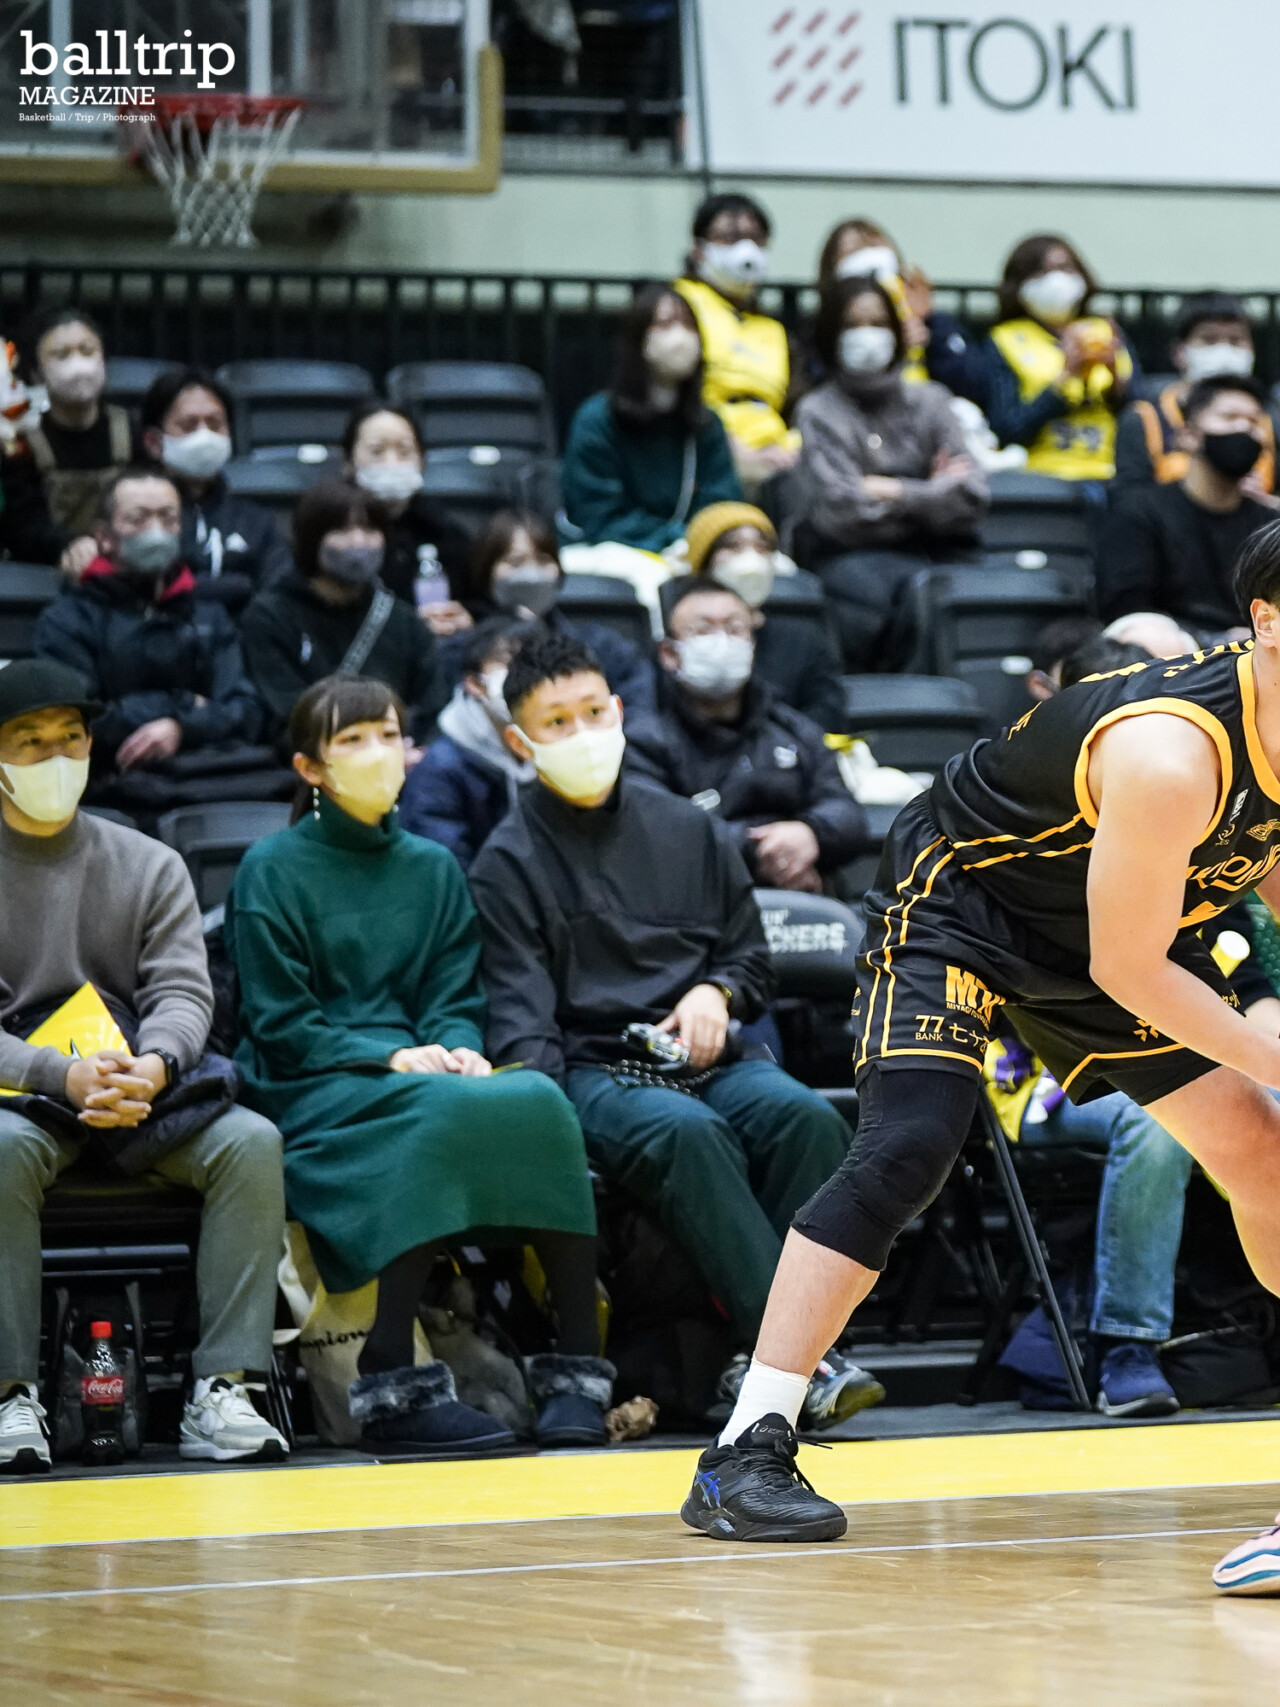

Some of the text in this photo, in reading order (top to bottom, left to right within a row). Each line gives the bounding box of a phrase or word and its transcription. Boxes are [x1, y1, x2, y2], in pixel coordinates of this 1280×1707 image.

[895, 18, 1136, 112] ITOKI
[915, 1014, 945, 1033] 77
[915, 1032, 944, 1041] BANK
